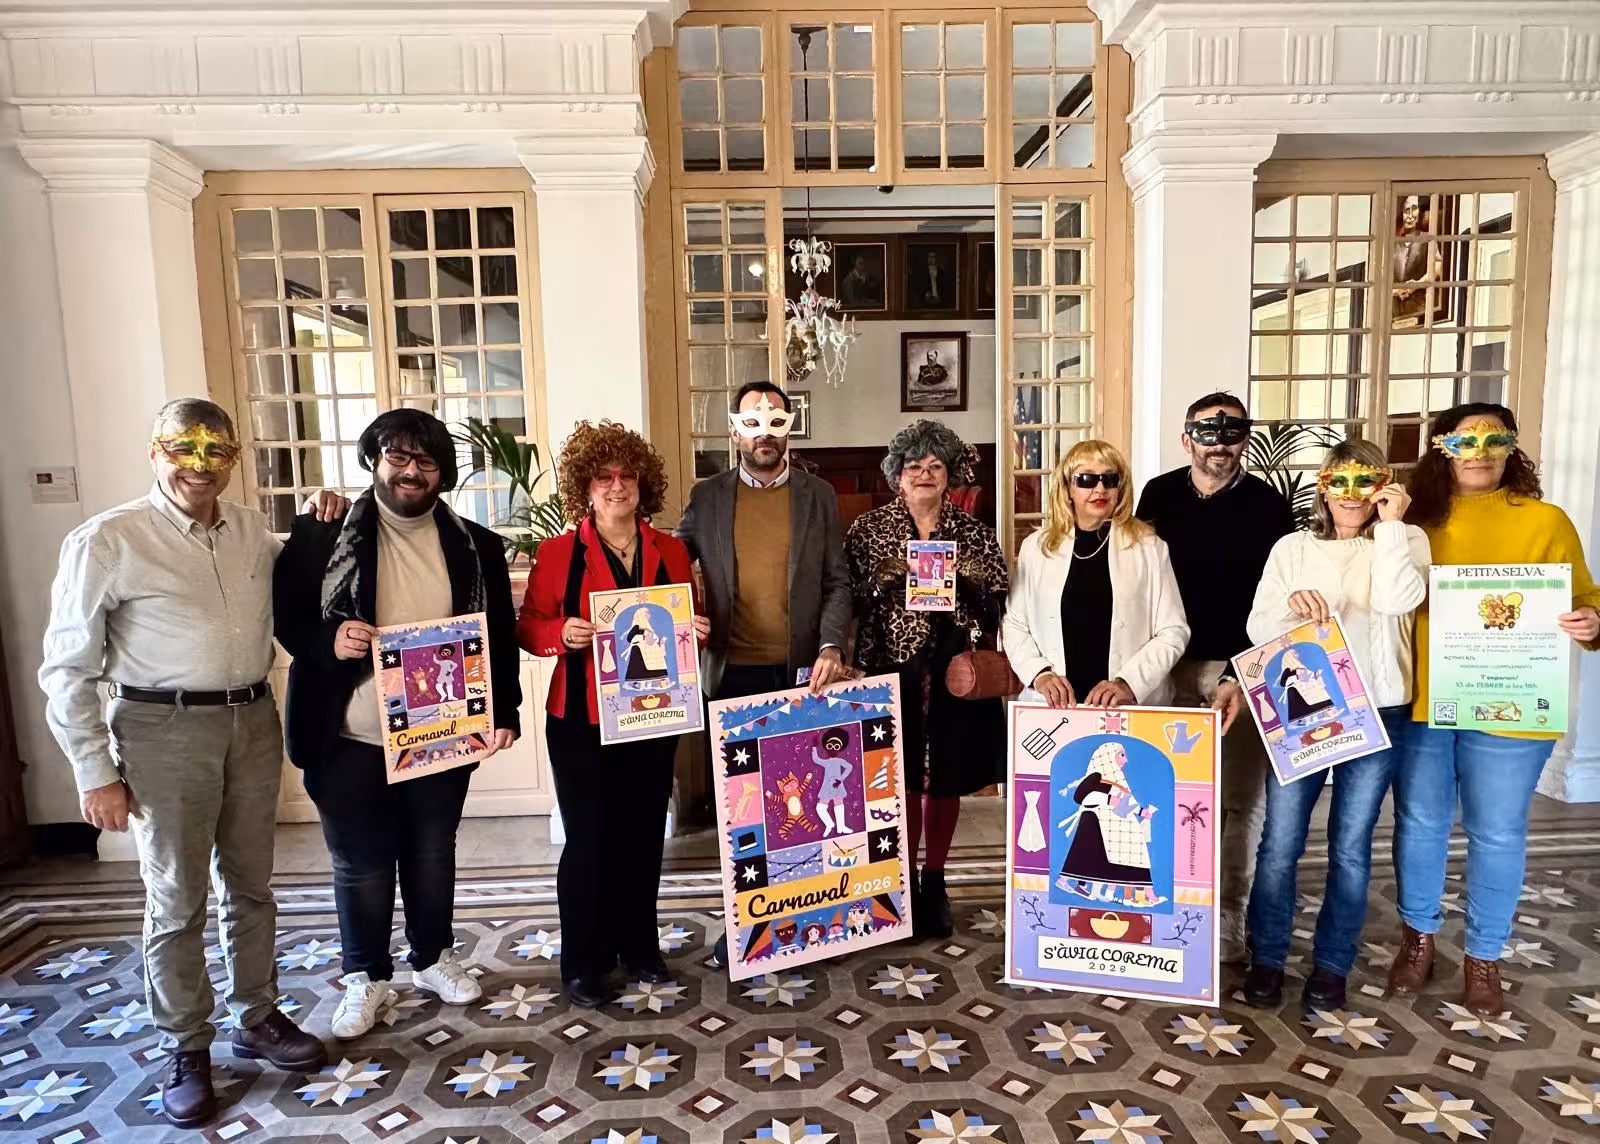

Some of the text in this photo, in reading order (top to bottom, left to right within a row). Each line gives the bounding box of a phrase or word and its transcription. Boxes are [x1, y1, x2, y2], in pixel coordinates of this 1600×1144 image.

[1457, 567, 1501, 577] PETITA
[396, 720, 457, 747] Carnaval
[748, 872, 892, 918] Carnaval 2026
[1101, 948, 1178, 974] COREMA
